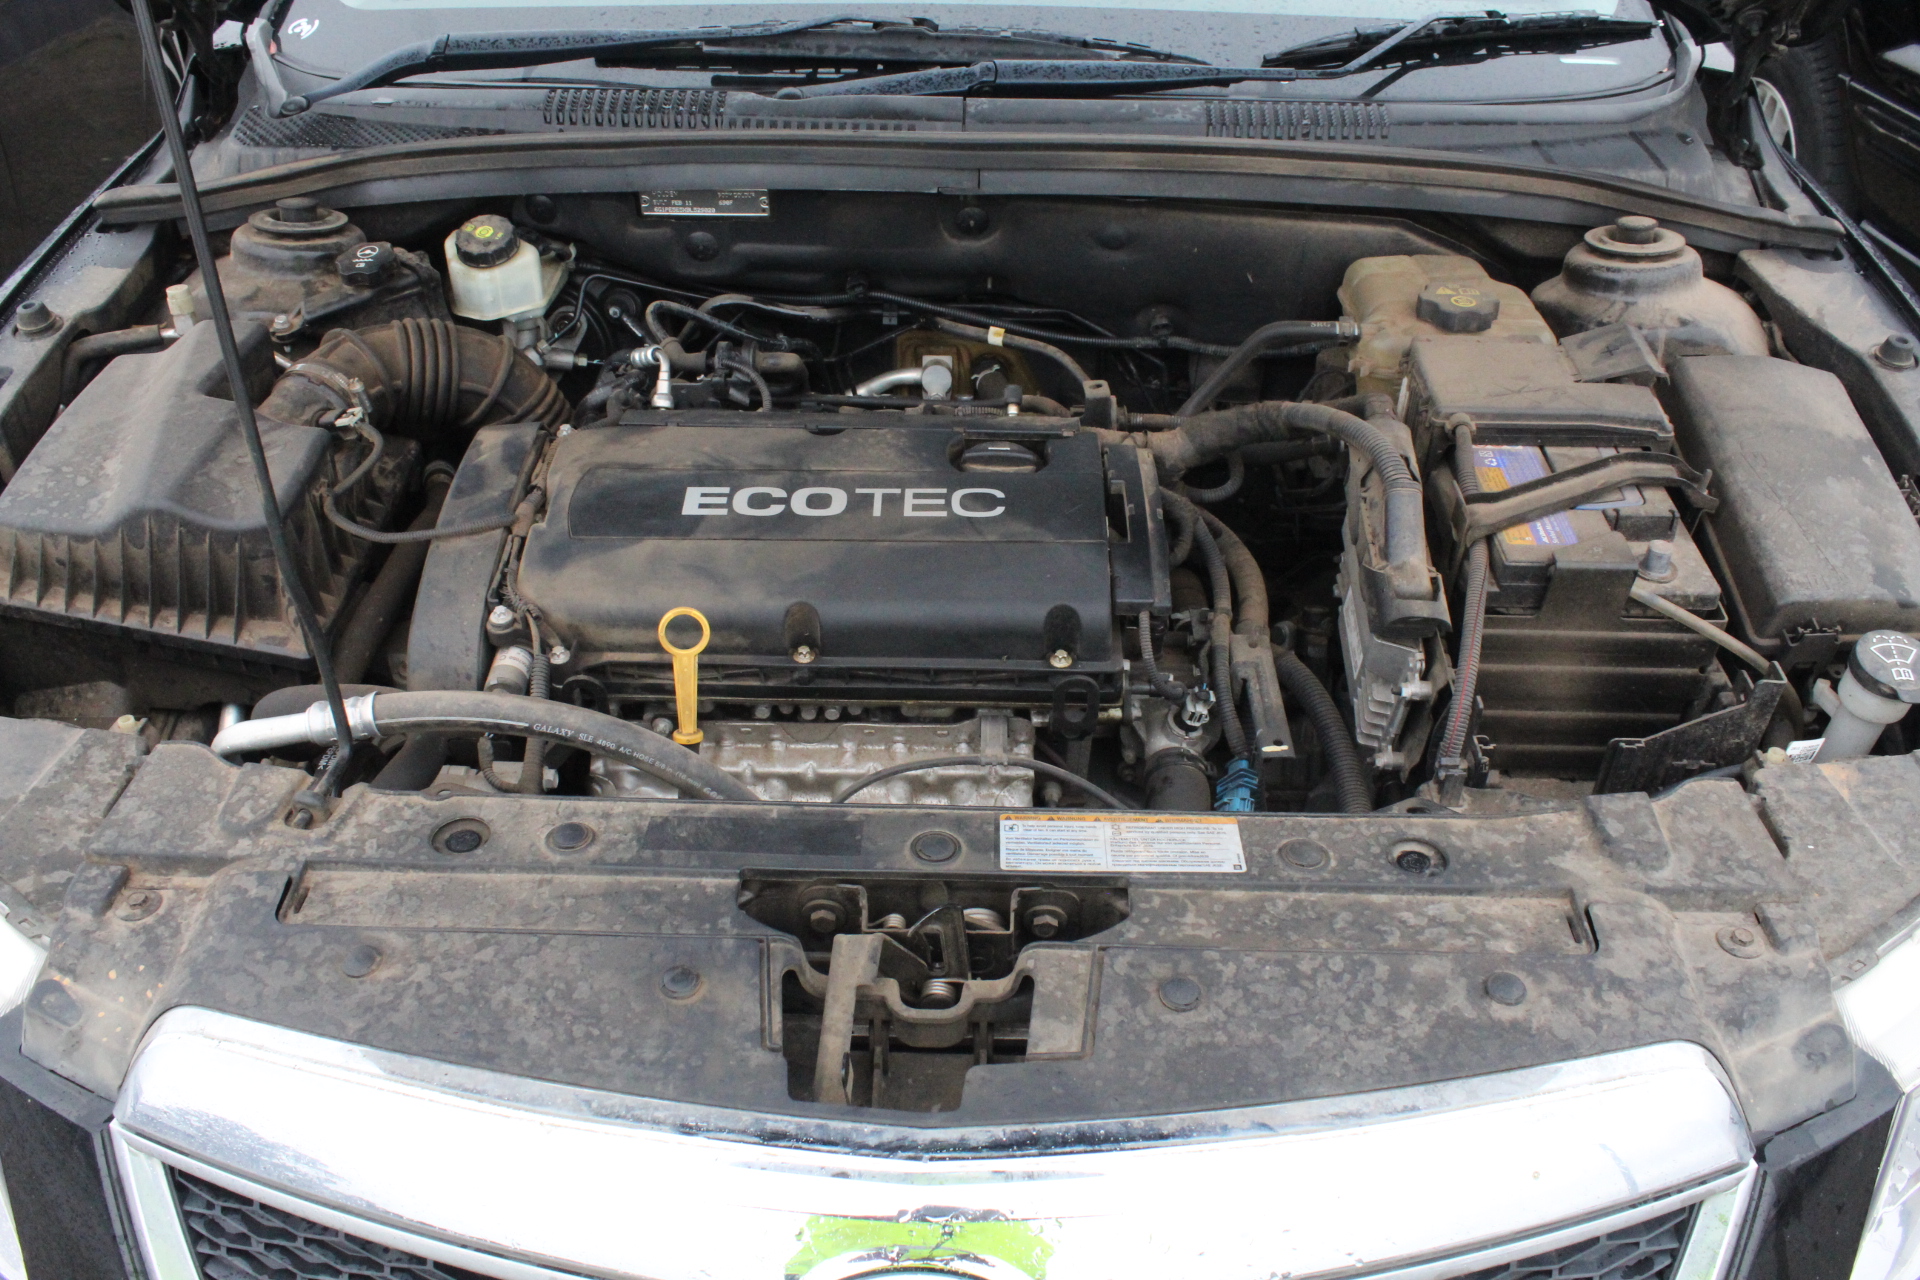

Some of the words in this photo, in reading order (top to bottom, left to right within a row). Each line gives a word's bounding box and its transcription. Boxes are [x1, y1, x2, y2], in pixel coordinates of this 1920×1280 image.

[681, 486, 1006, 518] ECOTEC
[533, 723, 575, 737] GALAXY
[578, 733, 594, 743] SLE
[619, 746, 633, 756] A/C
[632, 751, 655, 765] HOSE
